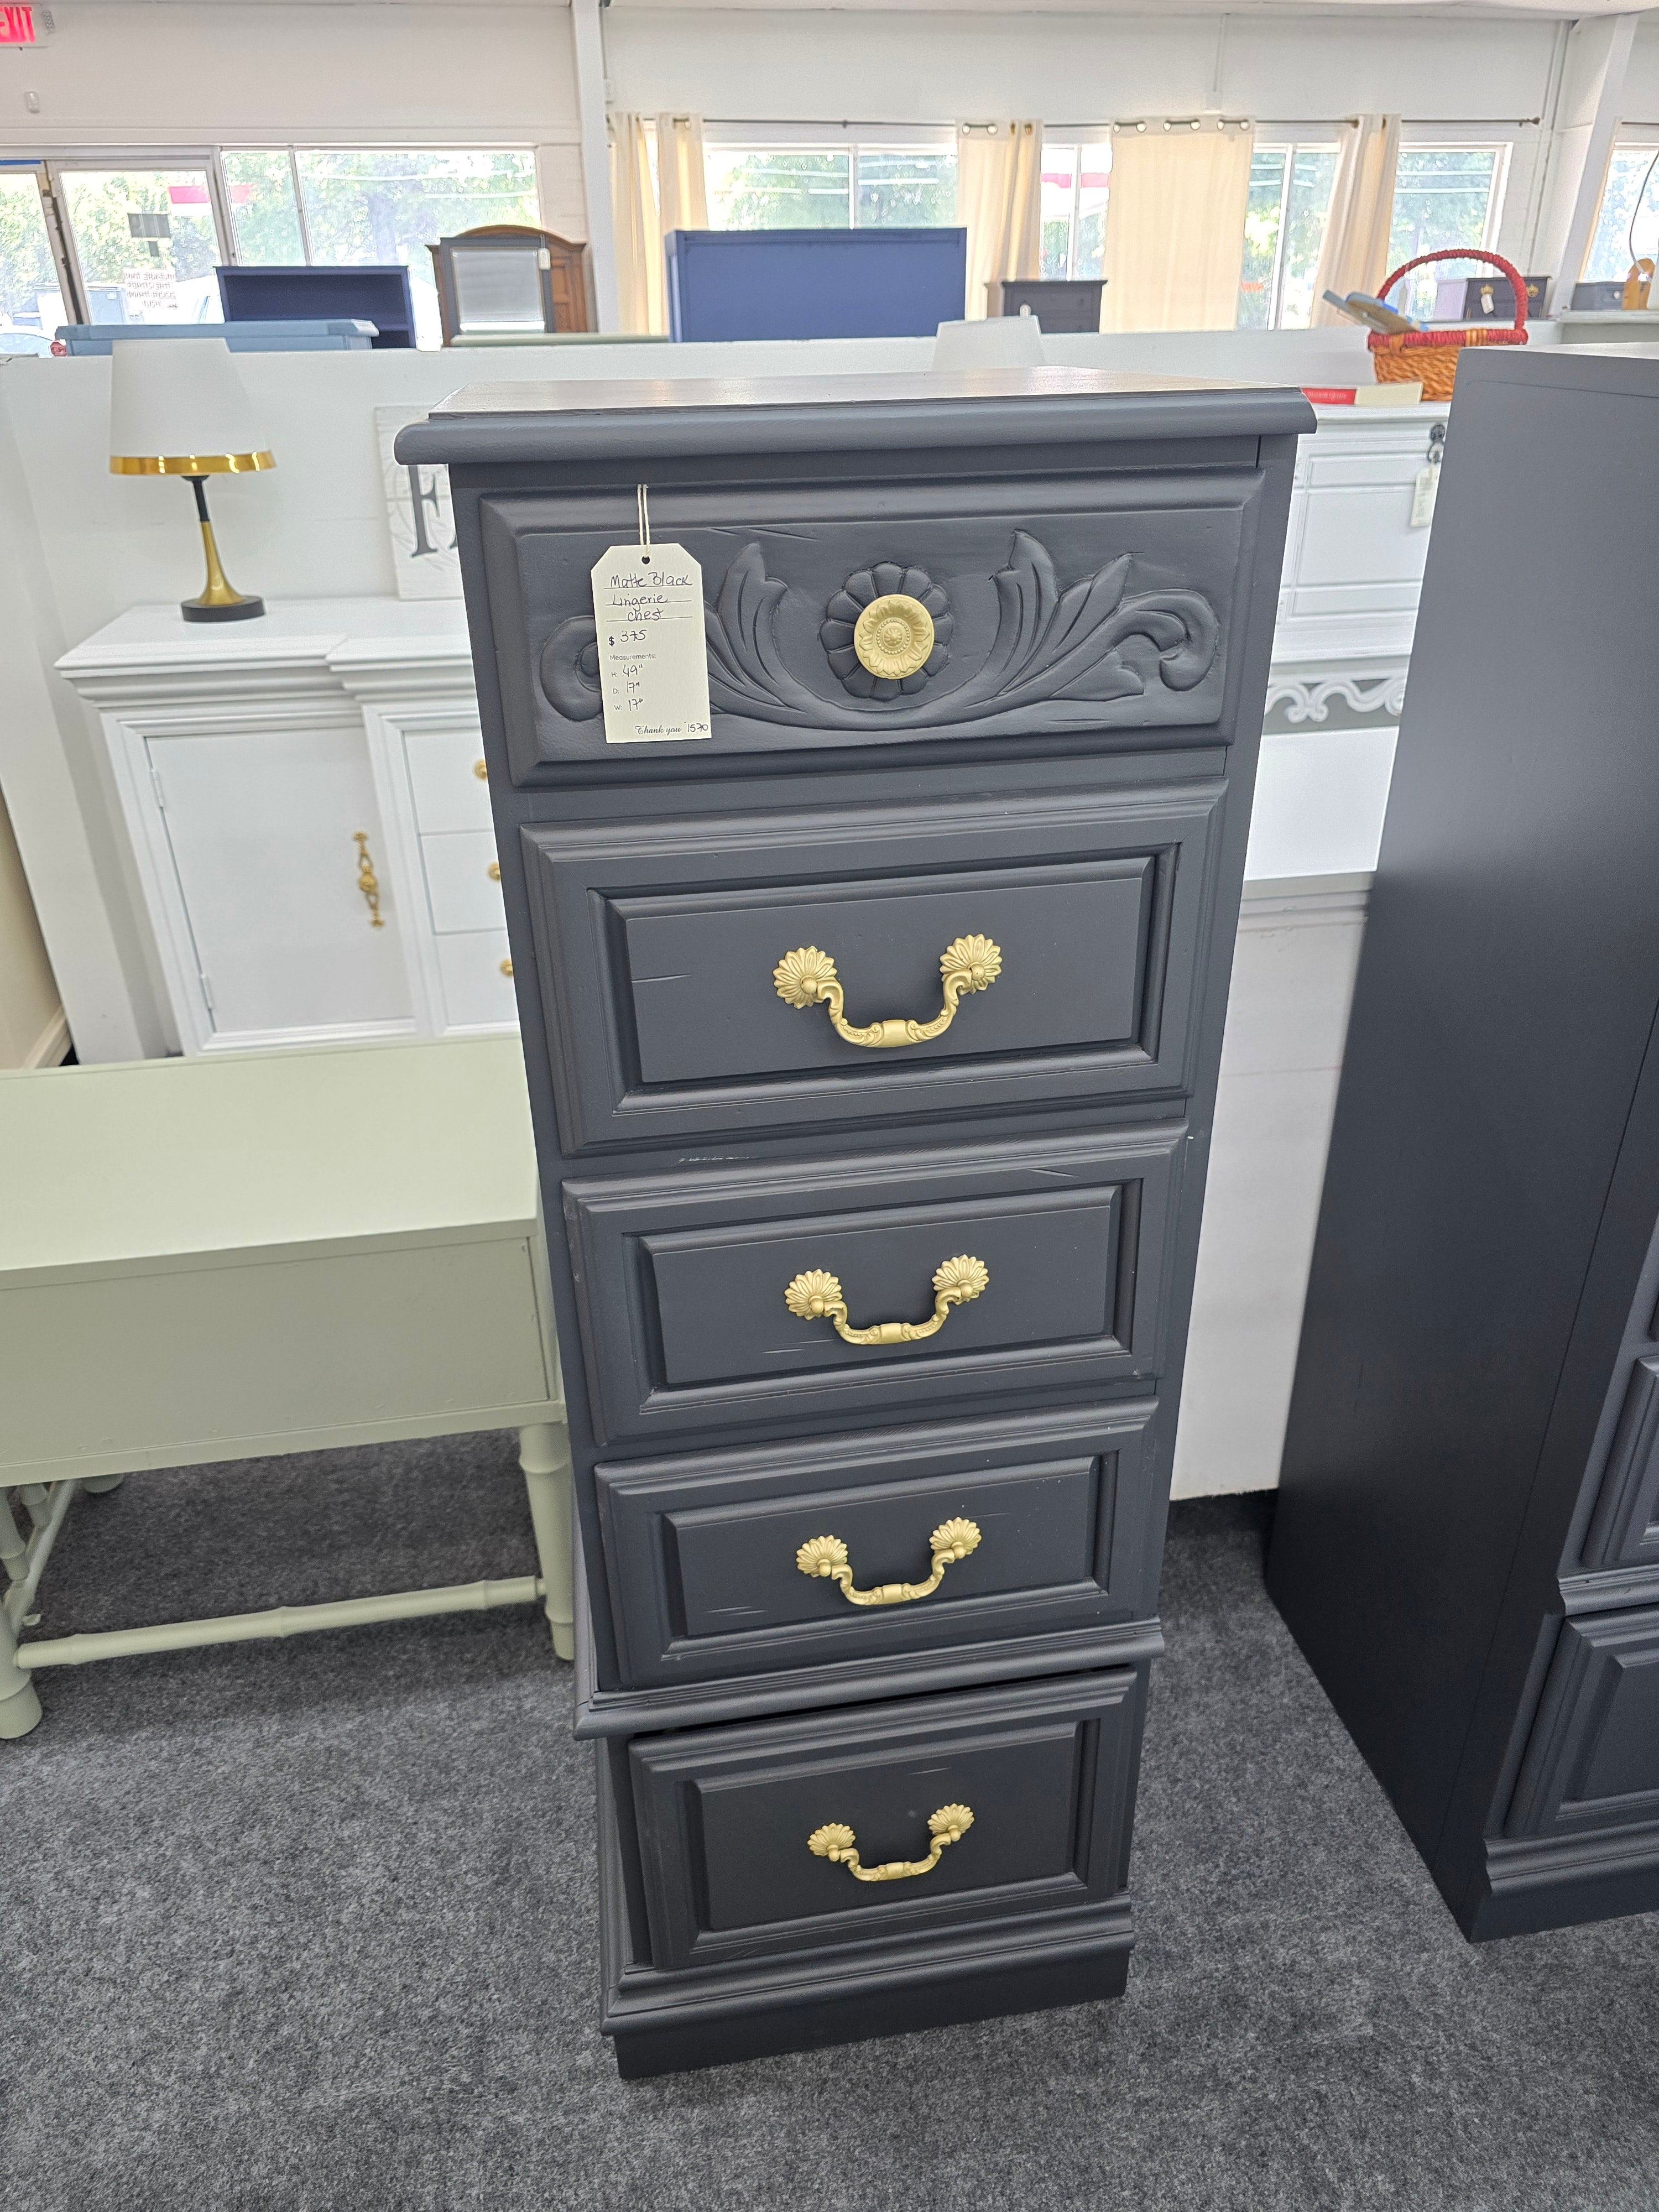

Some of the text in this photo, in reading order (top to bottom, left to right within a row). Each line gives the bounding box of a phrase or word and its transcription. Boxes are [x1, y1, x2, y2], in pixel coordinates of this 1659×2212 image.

[610, 572, 693, 588] Matte Black
[612, 593, 669, 611] Lingerie
[620, 629, 647, 642] 375
[623, 664, 643, 677] 49"
[627, 681, 640, 693] 17"
[628, 697, 643, 711] 17"
[634, 724, 665, 735] Thank
[665, 727, 682, 736] you
